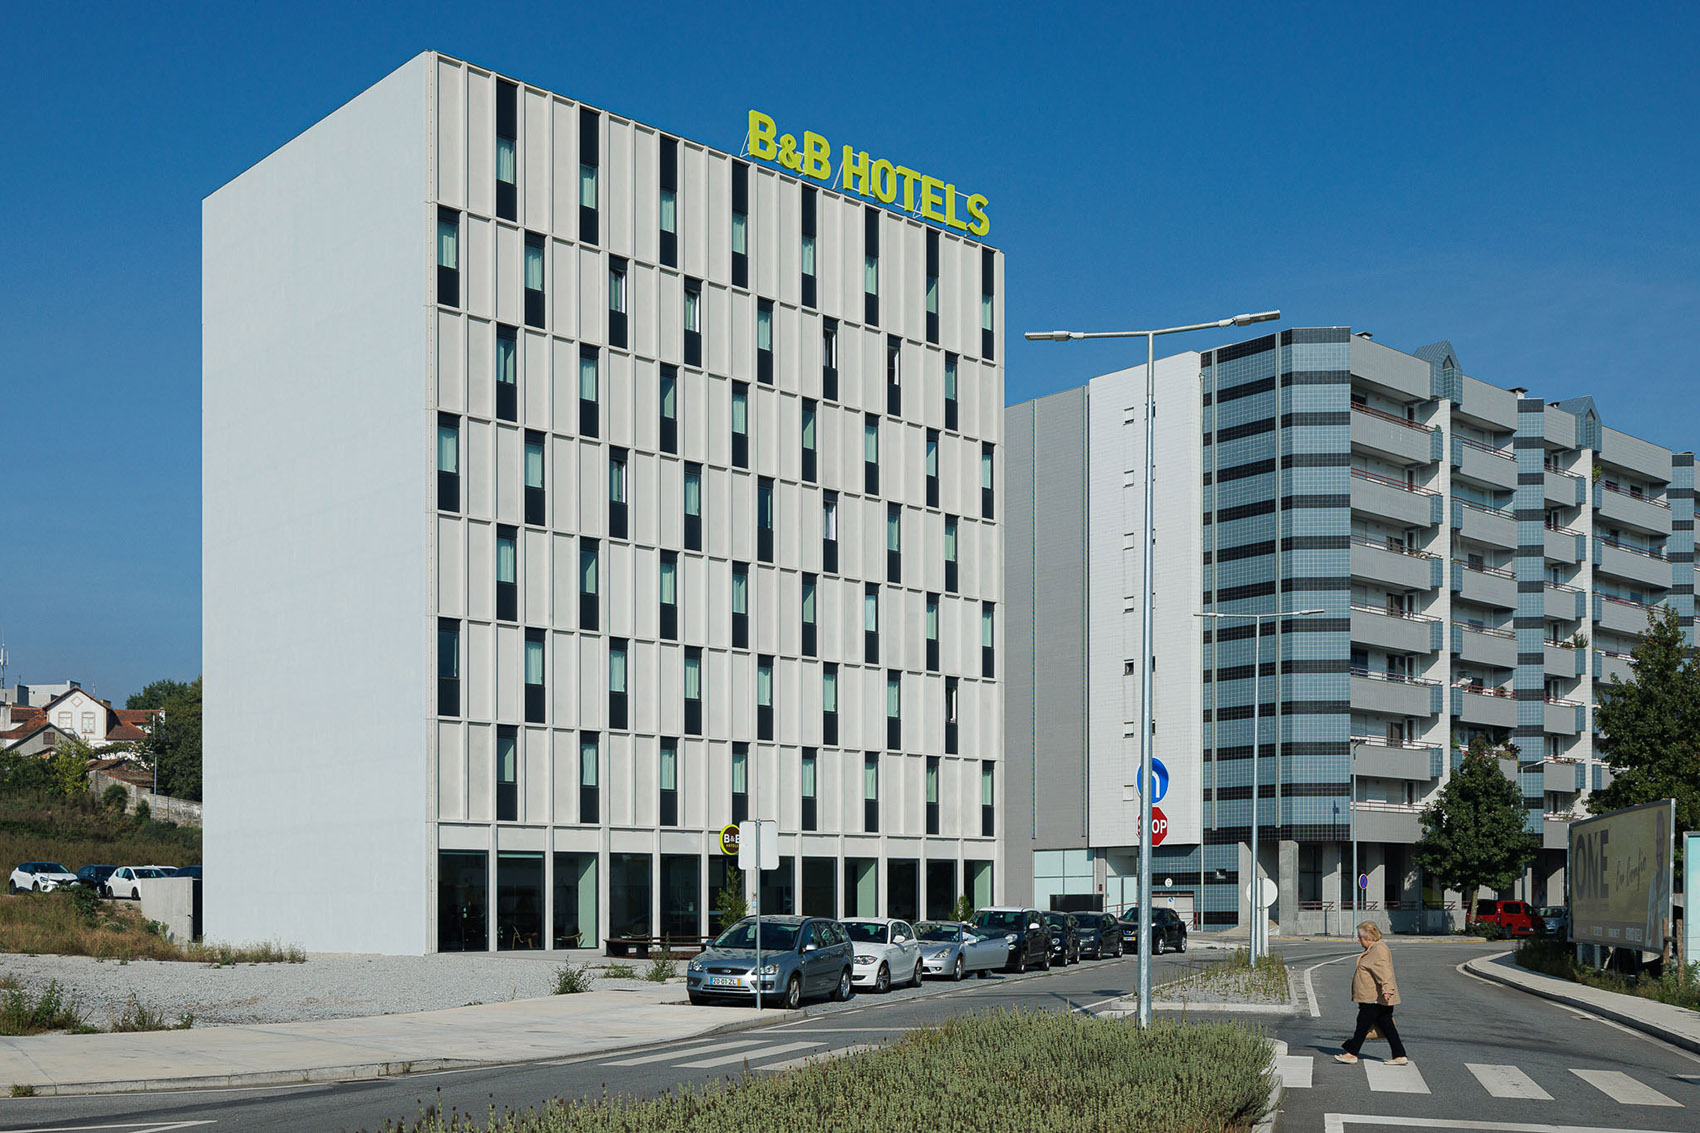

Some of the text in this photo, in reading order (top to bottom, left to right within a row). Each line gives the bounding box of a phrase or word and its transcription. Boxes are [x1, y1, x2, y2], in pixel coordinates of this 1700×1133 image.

[749, 109, 990, 236] B&B HOTELS
[1138, 819, 1167, 834] OP
[1575, 829, 1609, 900] ONE
